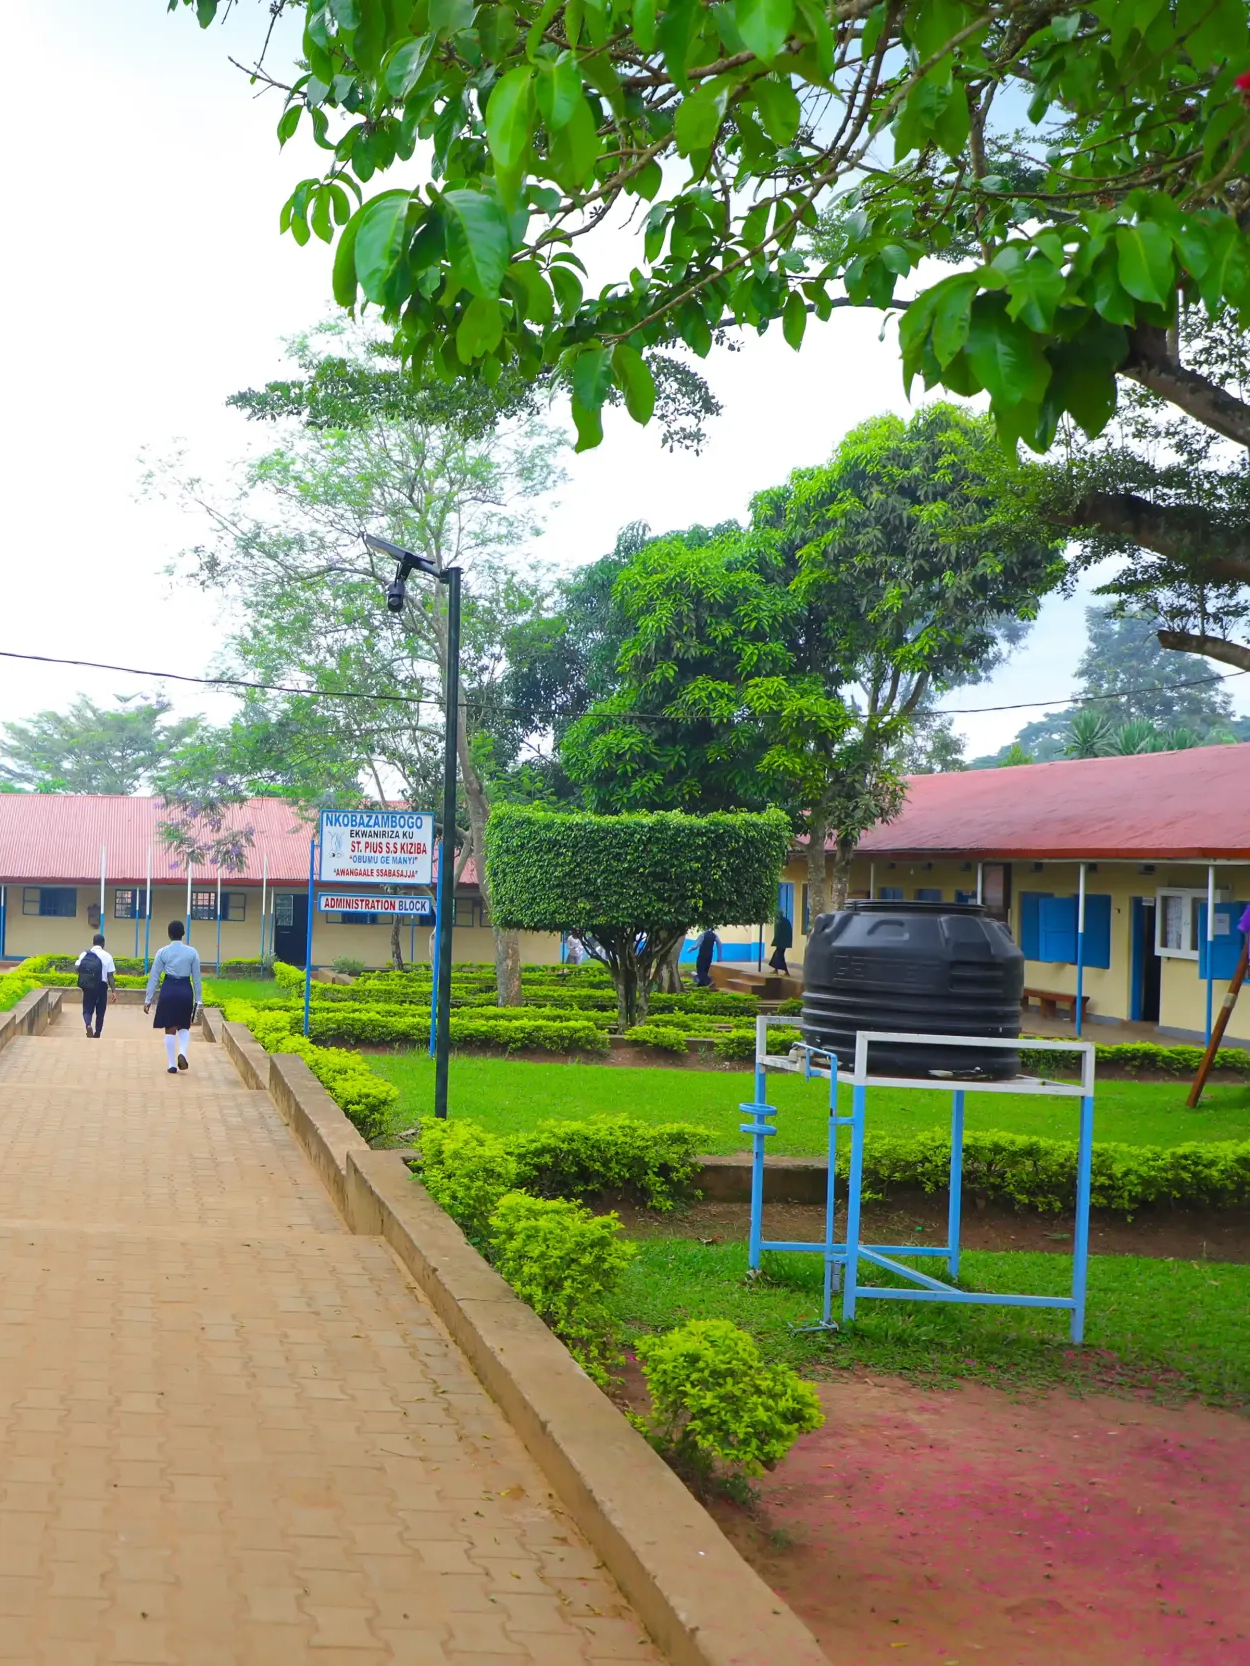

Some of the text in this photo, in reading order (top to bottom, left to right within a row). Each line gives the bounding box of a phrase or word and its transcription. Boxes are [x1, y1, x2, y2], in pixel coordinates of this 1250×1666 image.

[326, 814, 423, 829] NKOBAZAMBOGO
[350, 830, 414, 840] EKWANIRIZA KU
[350, 841, 427, 854] ST. PIUS S.S KIZIBA
[380, 856, 390, 864] GE
[324, 897, 426, 912] ADMINISTRATION BLOCK
